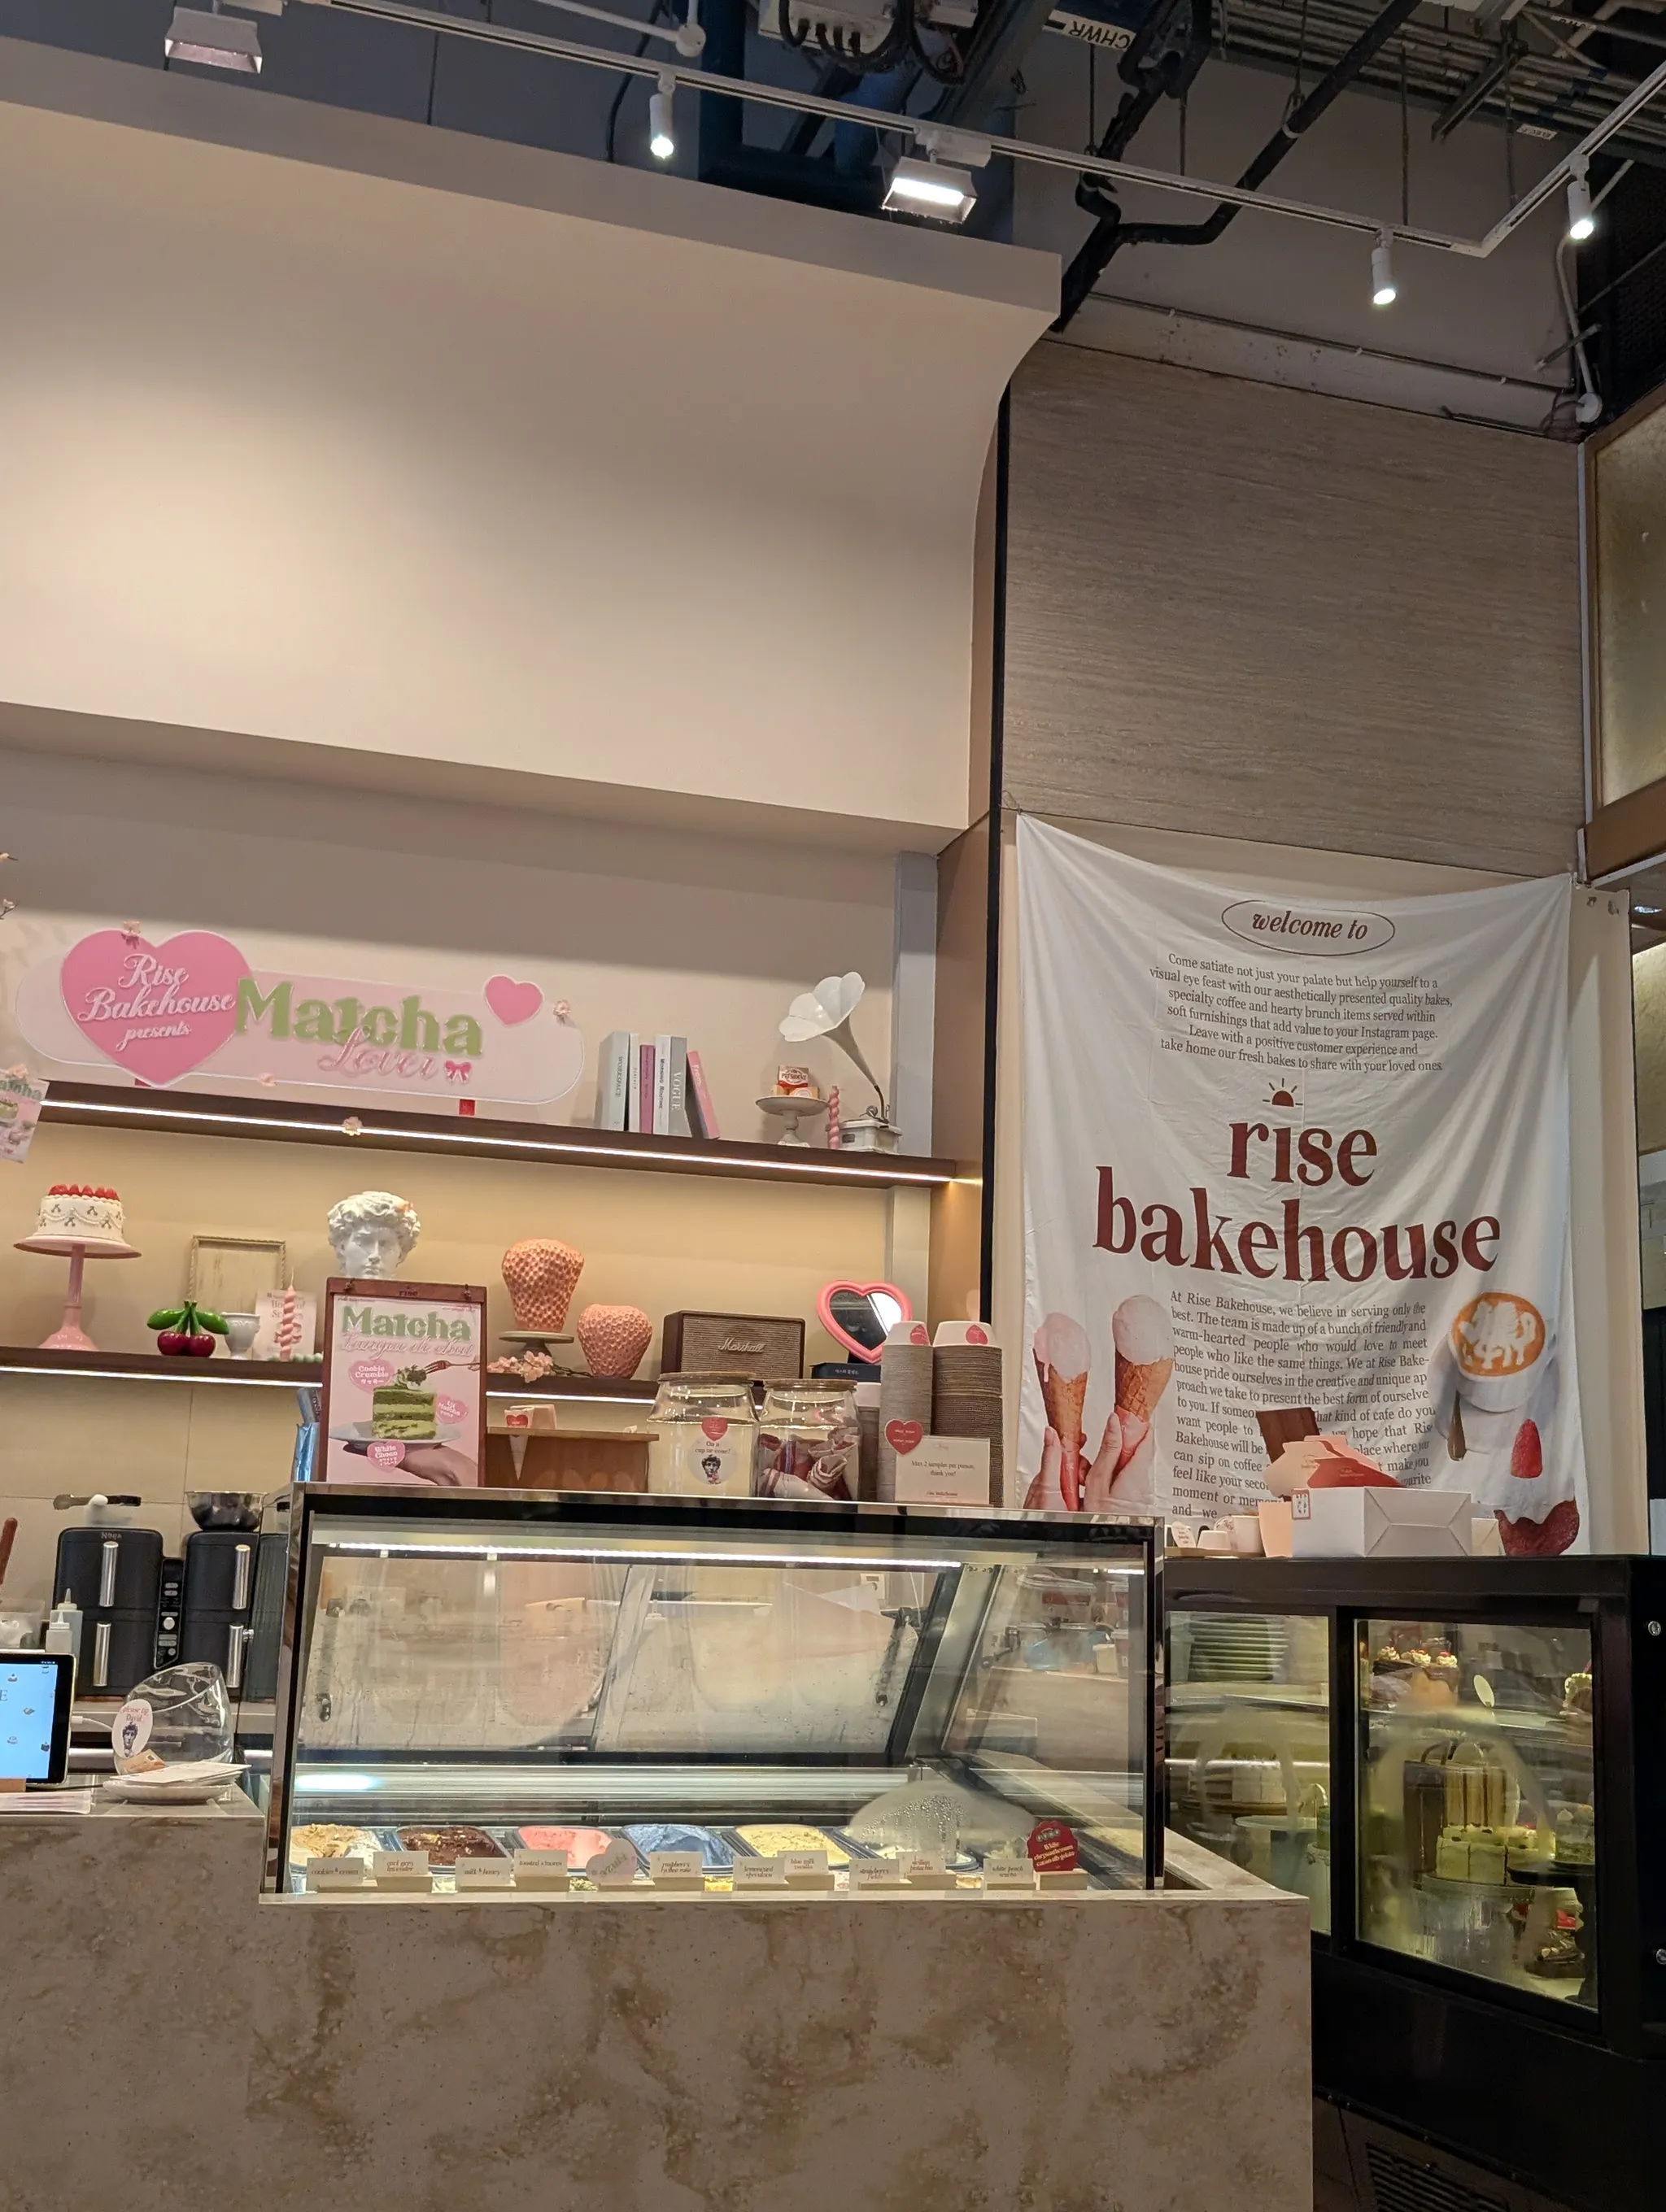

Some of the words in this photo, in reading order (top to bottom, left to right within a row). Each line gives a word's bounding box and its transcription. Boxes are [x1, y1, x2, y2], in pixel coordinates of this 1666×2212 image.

[1069, 21, 1130, 48] CHWR
[1252, 910, 1342, 938] welcome
[1347, 920, 1368, 940] to
[118, 953, 189, 988] Rise
[1168, 953, 1197, 969] Come
[1200, 961, 1233, 973] satiate
[1236, 967, 1253, 977] not
[1256, 969, 1274, 981] just
[1277, 972, 1300, 983] your
[1303, 974, 1333, 986] palate
[1336, 975, 1353, 987] but
[1355, 976, 1376, 989] help
[1380, 977, 1420, 989] yourself
[1420, 978, 1429, 988] to
[1432, 980, 1438, 988] a
[1149, 966, 1180, 982] visual
[1184, 974, 1199, 986] eye
[1203, 975, 1226, 989] feast
[1229, 980, 1251, 994] with
[1254, 986, 1272, 995] our
[1274, 987, 1337, 1005] aesthetically
[1339, 992, 1386, 1005] presented
[1389, 993, 1424, 1007] quality
[77, 984, 236, 1022] Bakehouse
[1169, 988, 1215, 1007] specialty
[1217, 995, 1246, 1009] coffee
[1250, 1002, 1267, 1012] and
[1271, 1004, 1302, 1019] hearty
[1305, 1006, 1341, 1020] brunch
[1343, 1008, 1371, 1021] items
[1373, 1010, 1404, 1021] served
[236, 978, 482, 1058] Matcha
[1167, 1005, 1187, 1017] soft
[1190, 1008, 1247, 1029] furnishings
[1250, 1017, 1270, 1030] that
[1273, 1021, 1292, 1033] add
[1294, 1023, 1321, 1036] value
[1324, 1026, 1333, 1036] to
[1336, 1027, 1359, 1038] your
[1361, 1027, 1409, 1039] Instagram
[116, 1021, 192, 1052] presents
[1189, 1025, 1219, 1039] Leave
[1222, 1030, 1243, 1043] with
[1247, 1036, 1252, 1044] a
[1255, 1036, 1294, 1050] positive
[1297, 1042, 1343, 1054] customer
[1345, 1044, 1398, 1056] experience
[1399, 1044, 1418, 1054] and
[1161, 1038, 1183, 1052] take
[1186, 1041, 1215, 1056] home
[1219, 1049, 1236, 1059] our
[1239, 1049, 1264, 1064] fresh
[1267, 1053, 1296, 1068] bakes
[1298, 1058, 1308, 1068] to
[1311, 1058, 1337, 1069] share
[1340, 1060, 1361, 1070] with
[1364, 1061, 1387, 1073] your
[1389, 1060, 1415, 1071] loved
[672, 1072, 681, 1110] VOGUE
[1227, 1121, 1378, 1187] rise
[1092, 1165, 1500, 1282] bakehouse
[1171, 1291, 1181, 1302] At
[1188, 1292, 1210, 1306] Rise
[1216, 1296, 1276, 1316] Bakehouse,
[1280, 1307, 1293, 1316] we
[1297, 1304, 1332, 1317] believe
[1337, 1305, 1346, 1317] in
[1351, 1304, 1389, 1318] serving
[342, 1305, 471, 1341] Matcha
[1197, 1312, 1218, 1325] The
[1221, 1316, 1248, 1330] team
[1251, 1318, 1259, 1330] is
[1263, 1320, 1290, 1333] made
[1308, 1322, 1318, 1334] of
[1328, 1322, 1360, 1334] bunch
[1408, 1319, 1426, 1330] and
[717, 1337, 765, 1352] Marshall
[1174, 1345, 1204, 1360] people
[1206, 1350, 1230, 1362] who
[1234, 1352, 1253, 1365] like
[1258, 1355, 1274, 1366] the
[1347, 1359, 1363, 1369] We
[1366, 1358, 1375, 1368] at
[1254, 1339, 1289, 1353] people
[1297, 1340, 1318, 1352] who
[1326, 1340, 1357, 1351] would
[1363, 1340, 1384, 1351] love
[1402, 1339, 1428, 1349] meet
[1175, 1360, 1202, 1375] house
[1204, 1367, 1229, 1380] pride
[1232, 1372, 1282, 1386] ourselves
[1297, 1374, 1314, 1387] the
[1316, 1375, 1356, 1387] creative
[1177, 1380, 1207, 1394] proach
[1210, 1386, 1223, 1396] we
[1225, 1387, 1247, 1400] take
[1304, 1393, 1321, 1405] the
[1323, 1392, 1344, 1404] best
[1176, 1416, 1202, 1428] want
[1206, 1421, 1238, 1435] people
[1335, 1410, 1356, 1422] kind
[1175, 1431, 1229, 1450] Bakehouse
[1231, 1439, 1249, 1452] will
[1352, 1427, 1378, 1441] hope
[1385, 1425, 1407, 1436] that
[1174, 1451, 1193, 1462] can
[1198, 1452, 1215, 1468] sip
[1219, 1458, 1230, 1467] on
[1234, 1459, 1262, 1472] coffee
[1173, 1465, 1193, 1479] feel
[1197, 1470, 1216, 1483] like
[1219, 1476, 1243, 1487] your
[1172, 1487, 1219, 1502] moment
[1172, 1504, 1192, 1516] and
